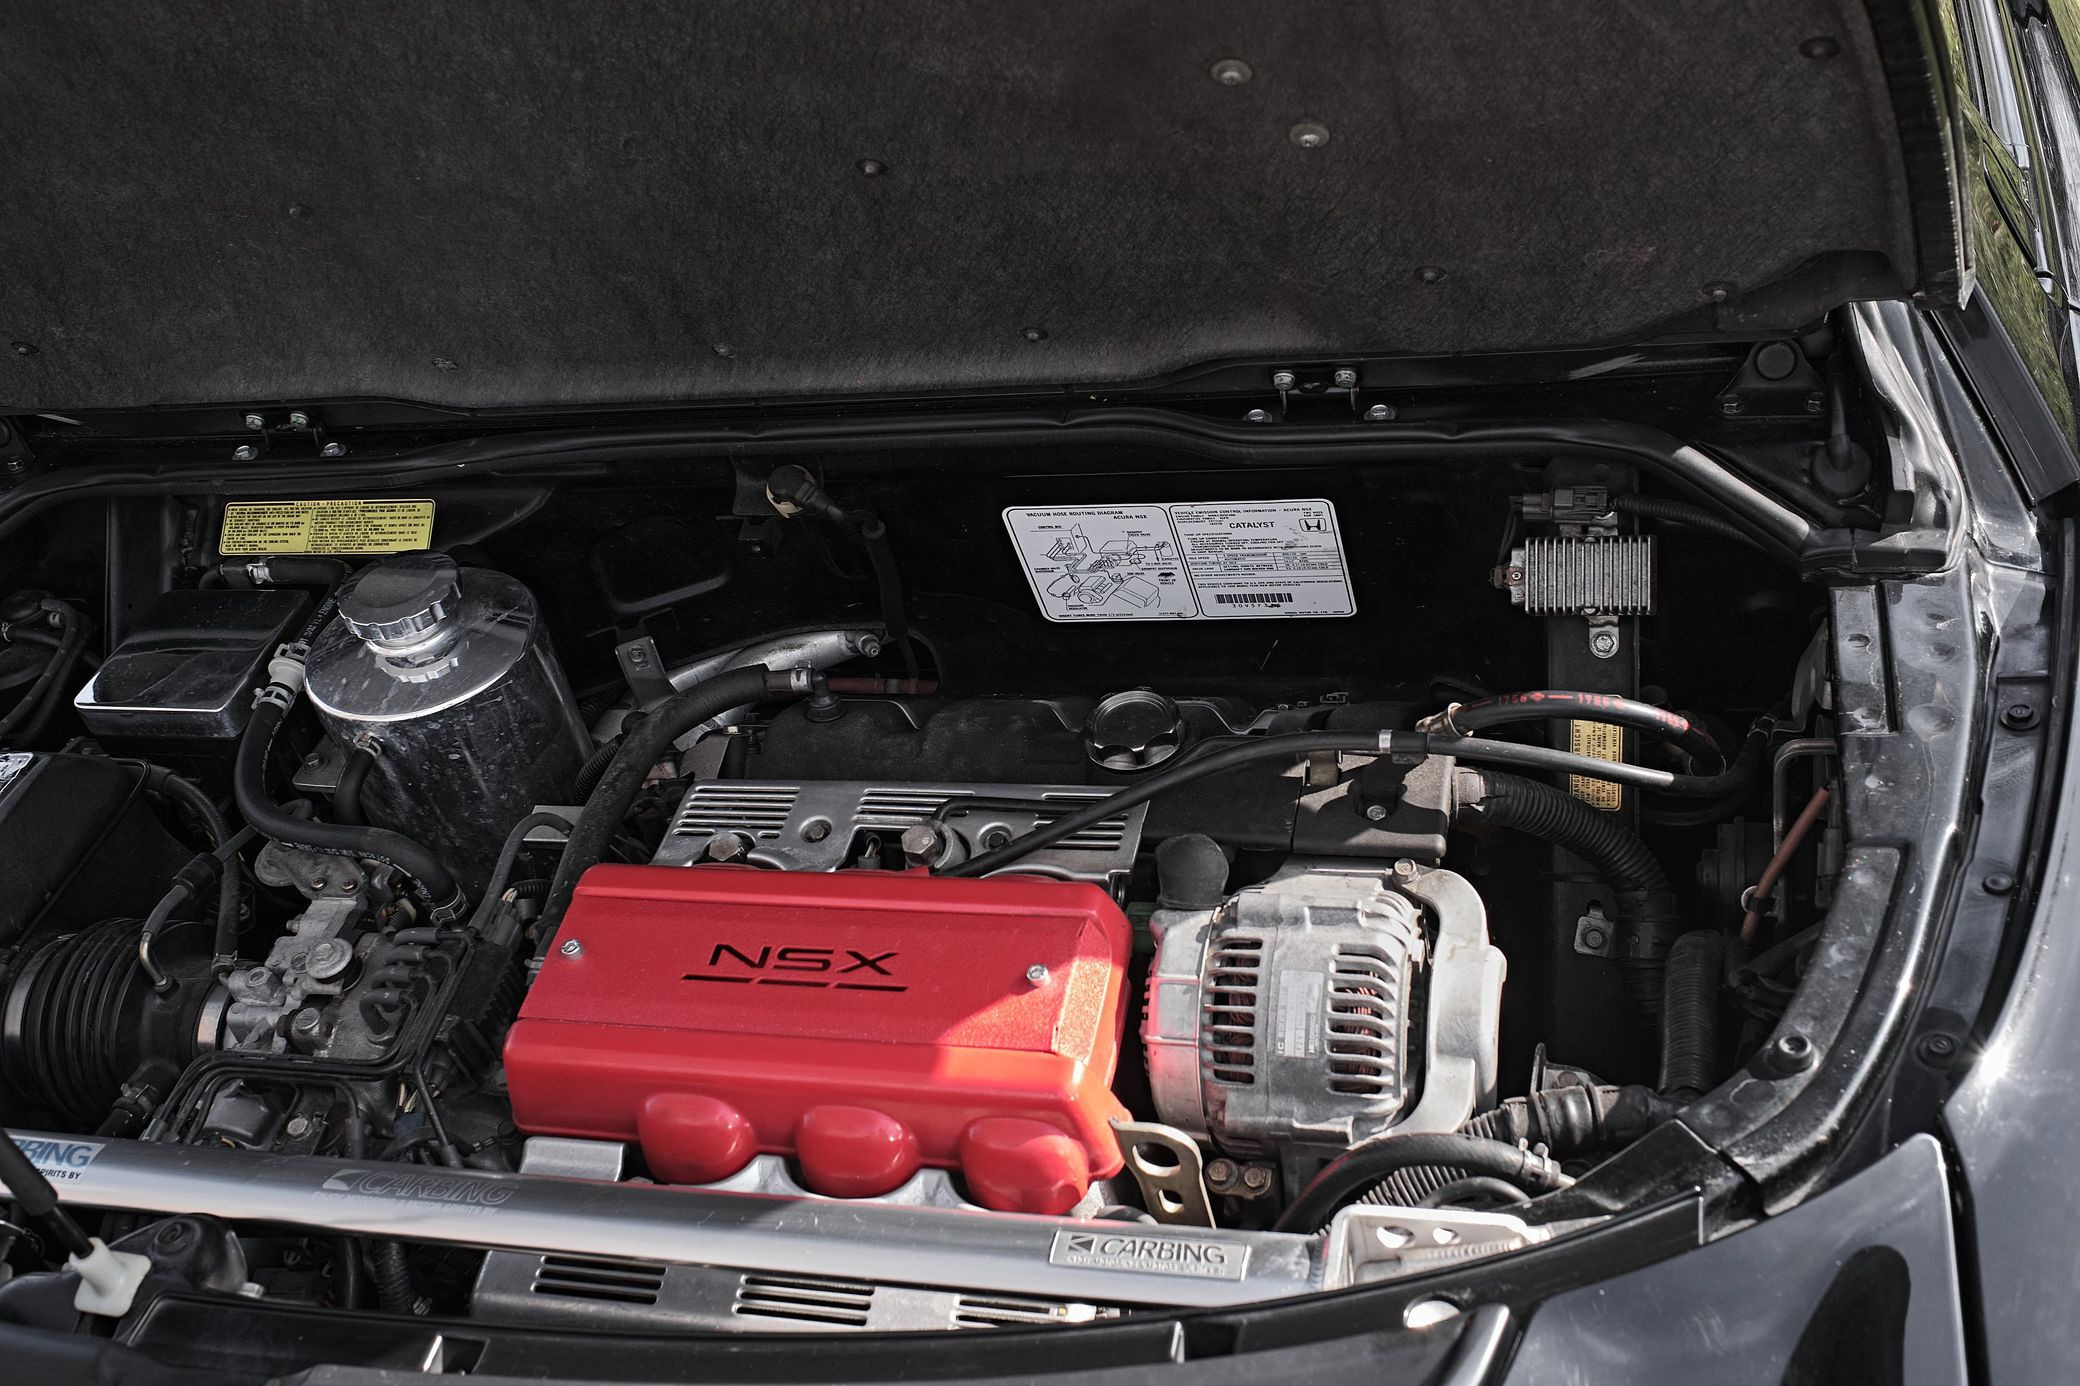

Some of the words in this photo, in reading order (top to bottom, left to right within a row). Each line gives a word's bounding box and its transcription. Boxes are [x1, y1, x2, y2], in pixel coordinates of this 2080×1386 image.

[1229, 521, 1275, 529] CATALYST
[708, 943, 899, 975] NSX
[13, 1139, 93, 1169] BING
[38, 1169, 67, 1178] PIRITS
[68, 1171, 82, 1180] BY
[358, 1171, 519, 1205] CARBING
[1101, 1238, 1227, 1264] CARBING
